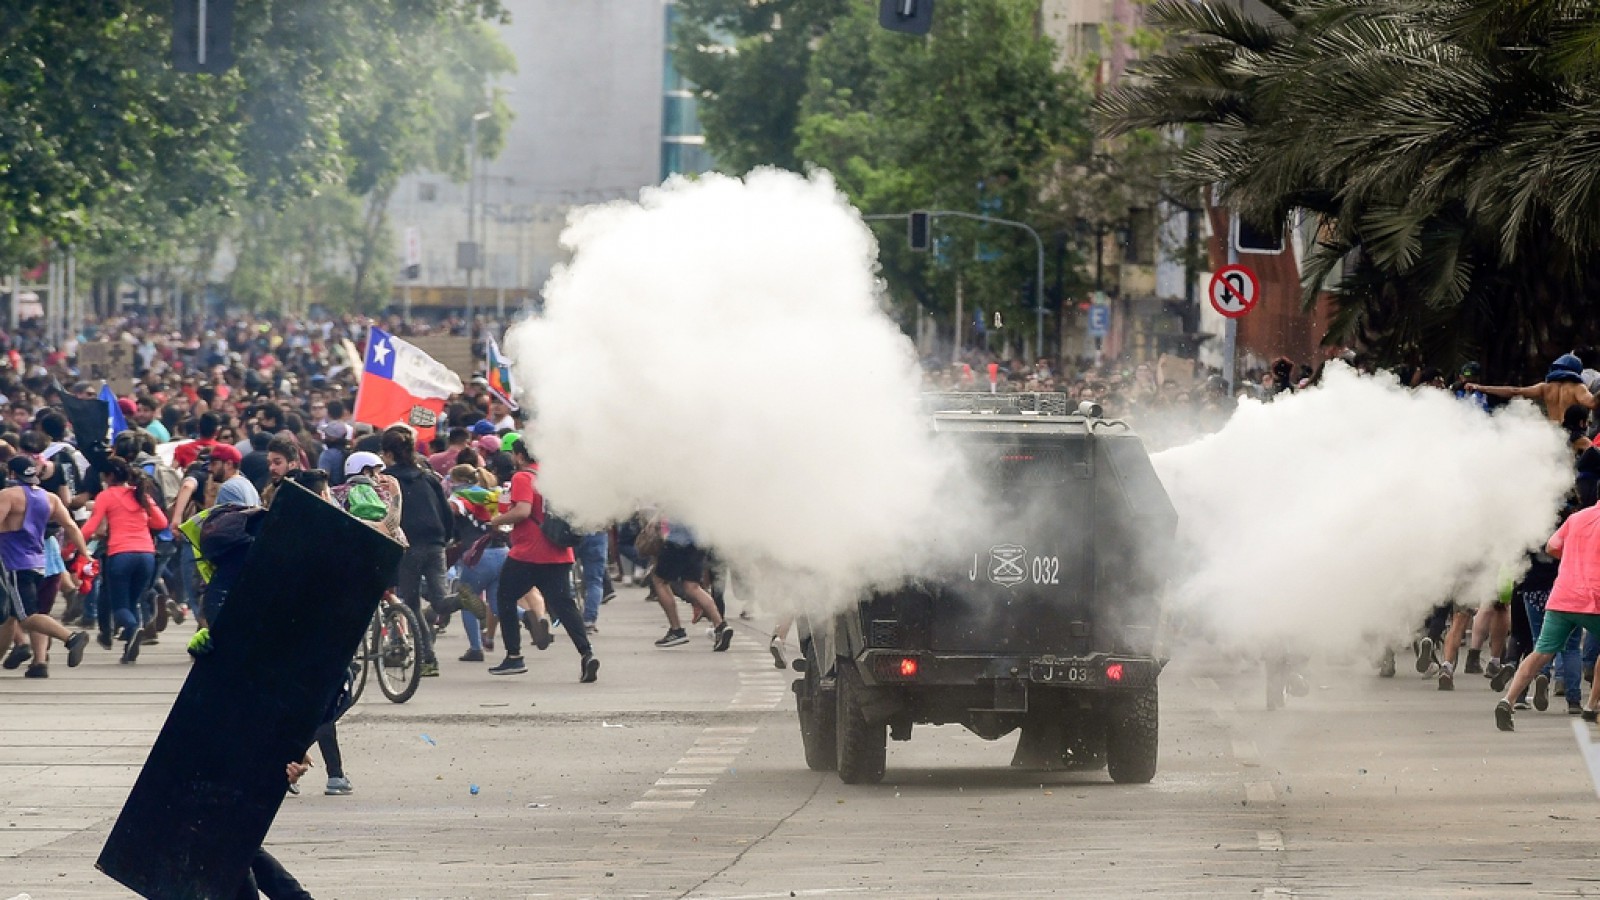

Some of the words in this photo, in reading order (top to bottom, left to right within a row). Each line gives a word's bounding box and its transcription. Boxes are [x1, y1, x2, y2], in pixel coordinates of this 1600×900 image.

[1092, 308, 1104, 328] E
[968, 552, 978, 582] J
[1032, 555, 1059, 584] 032
